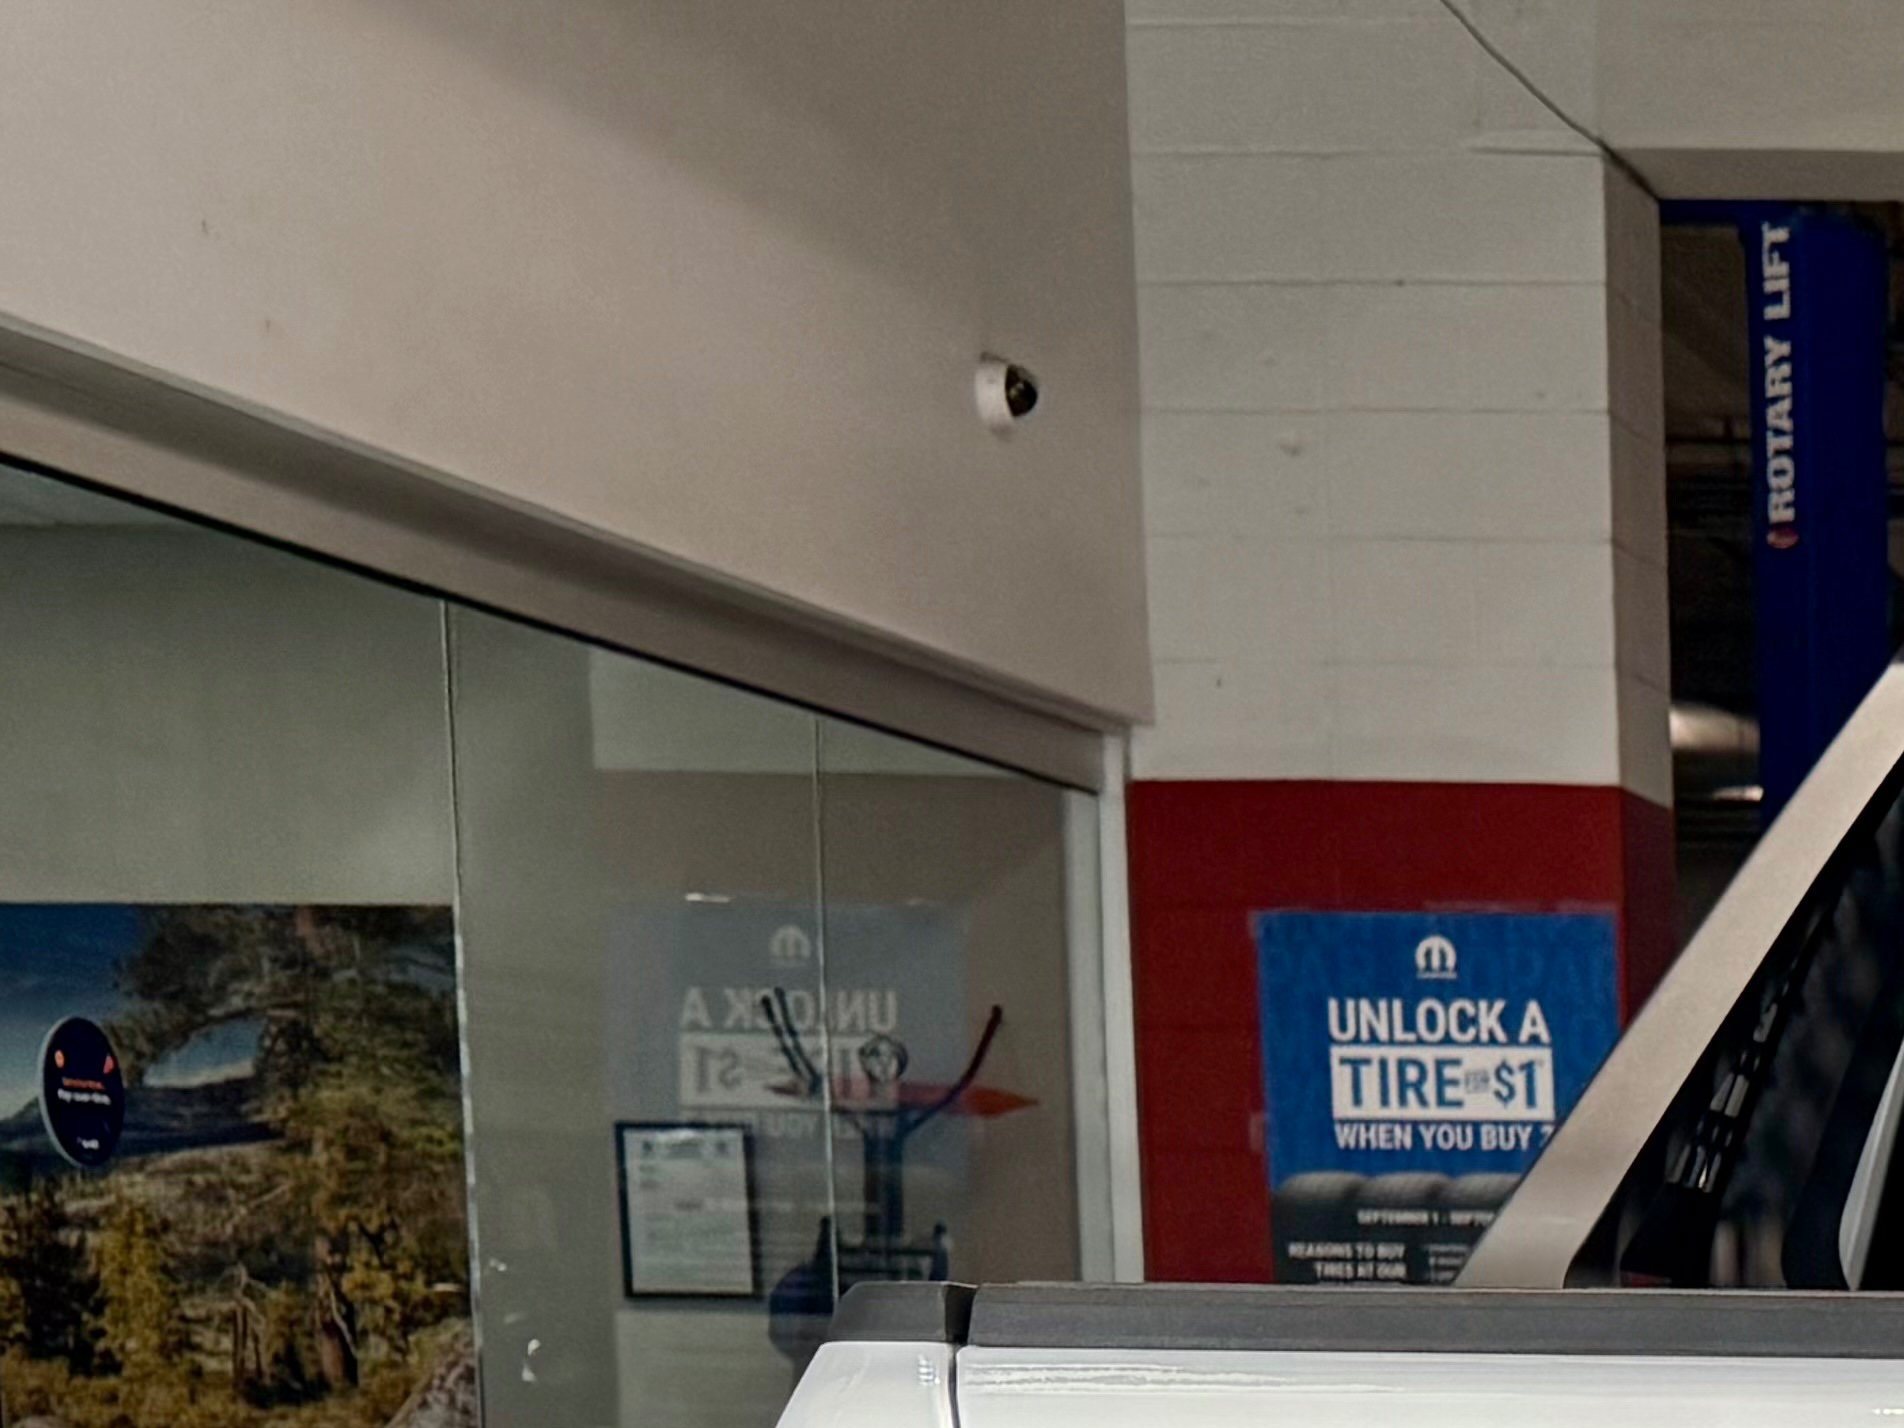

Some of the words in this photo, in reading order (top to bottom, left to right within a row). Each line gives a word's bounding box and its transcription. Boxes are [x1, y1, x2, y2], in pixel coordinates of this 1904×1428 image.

[1761, 221, 1791, 321] LIFT
[1763, 336, 1796, 524] ROTARY
[1327, 997, 1508, 1043] UNLOCK
[1518, 999, 1551, 1044] A
[1338, 1057, 1465, 1109] TIRE
[1334, 1122, 1412, 1151] WHEN
[1418, 1123, 1473, 1151] YOU
[1481, 1124, 1533, 1152] BUY
